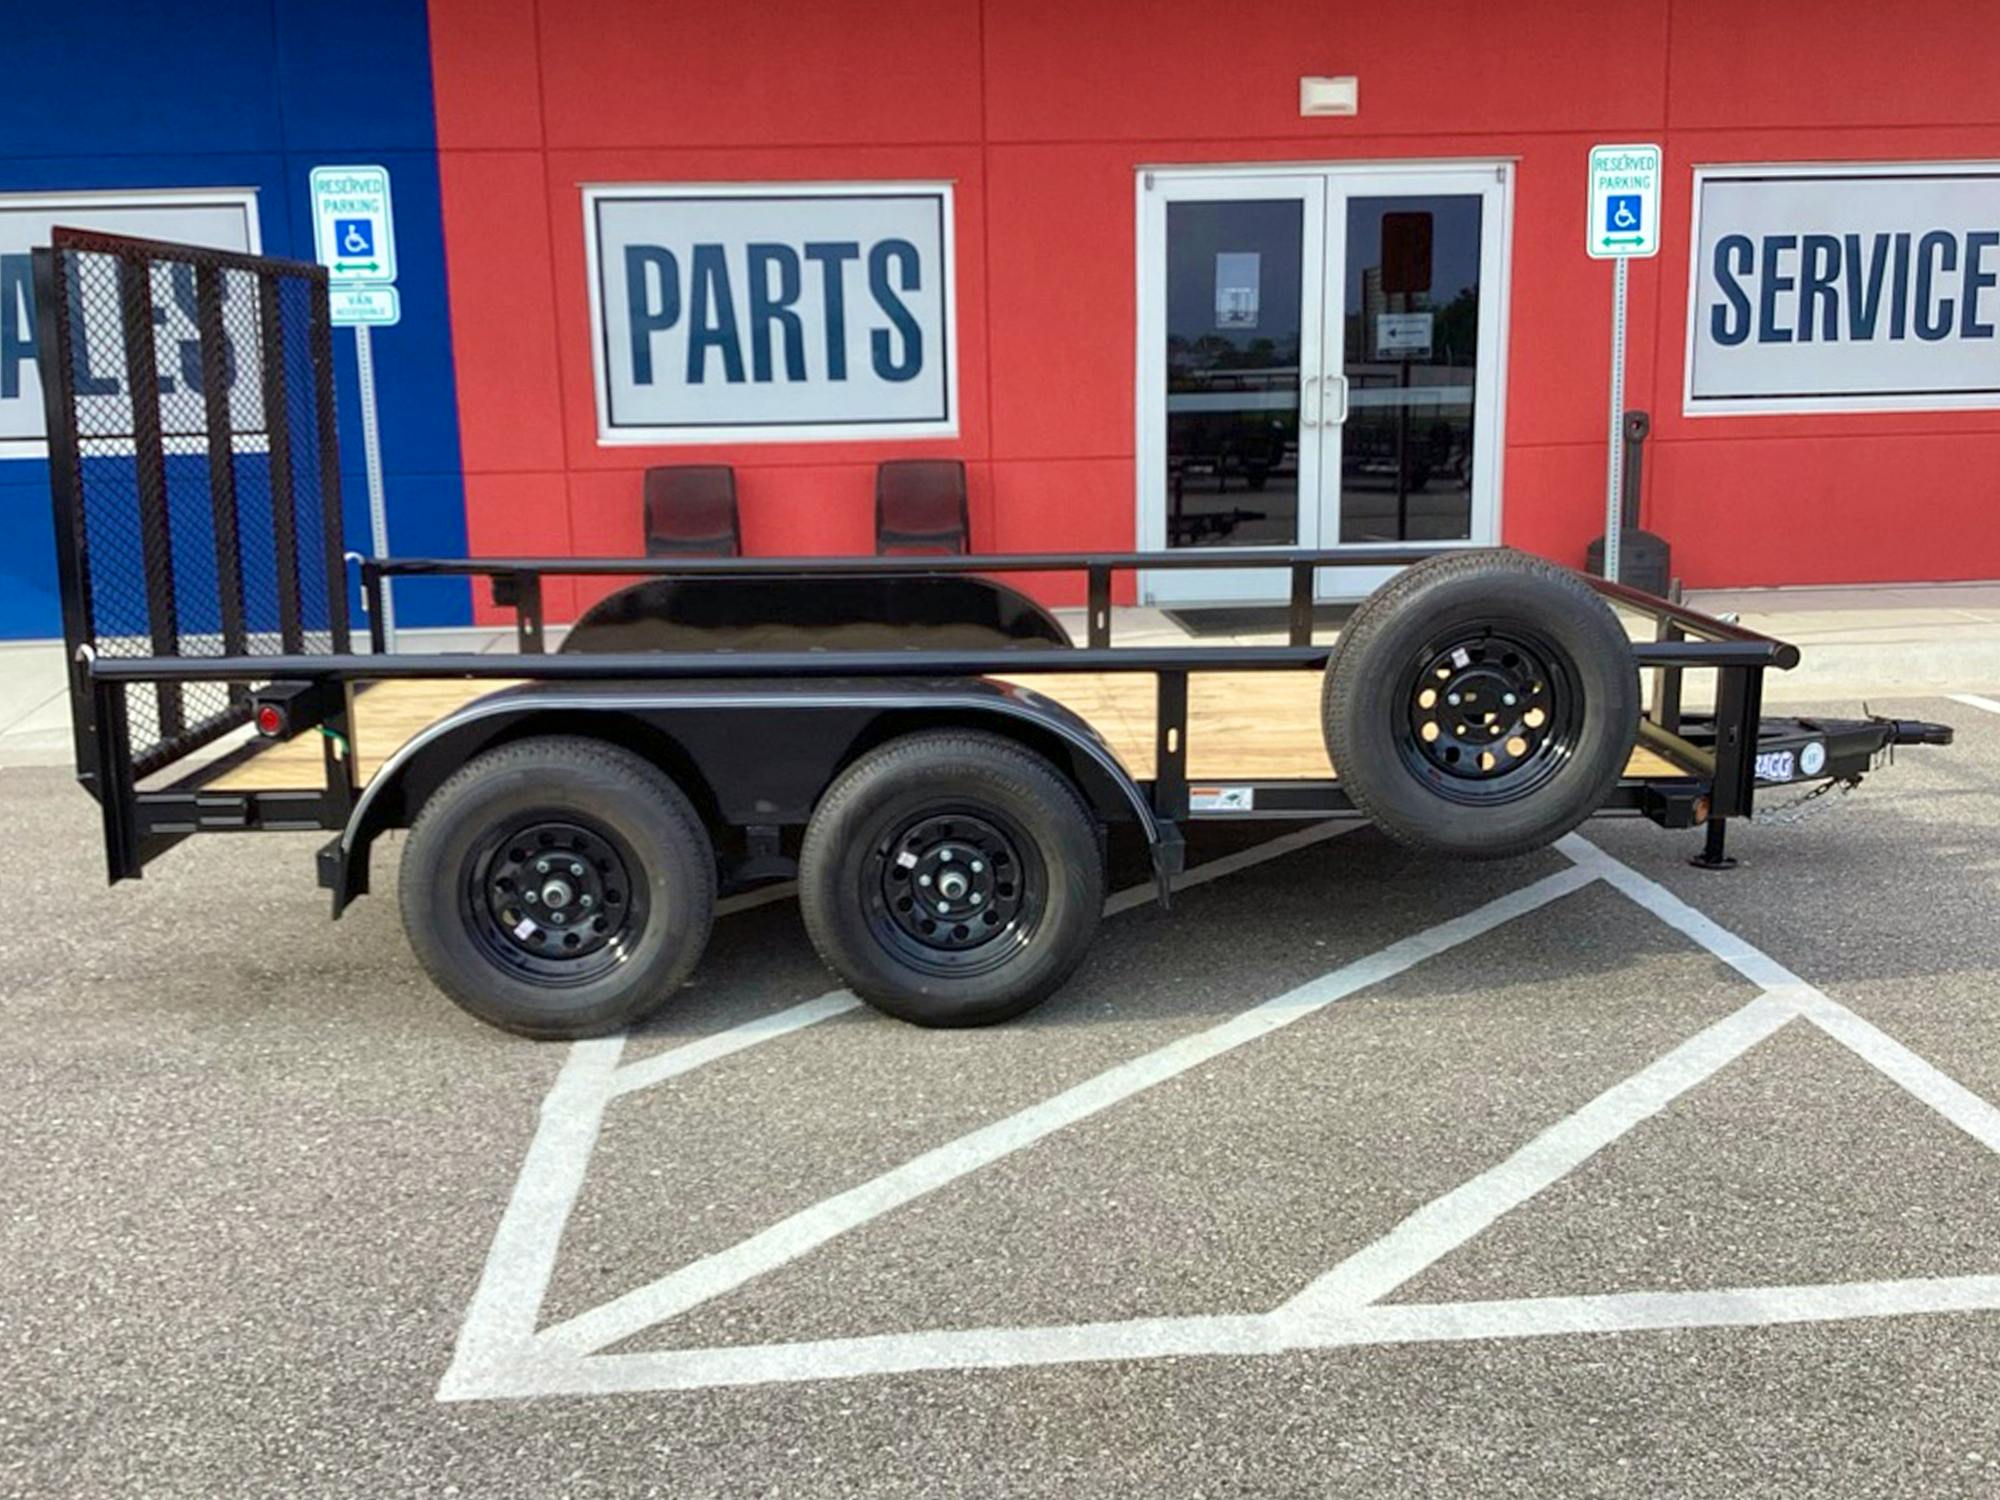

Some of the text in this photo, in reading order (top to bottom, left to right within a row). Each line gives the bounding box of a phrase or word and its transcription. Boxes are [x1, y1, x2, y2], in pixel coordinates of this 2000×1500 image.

[1594, 157, 1654, 171] RESERVED
[316, 178, 381, 194] RESERVED
[1599, 176, 1650, 189] PARKING
[323, 198, 380, 213] PARKING
[1711, 230, 2000, 346] SERVICE
[346, 295, 373, 305] VAN
[624, 238, 923, 384] PARTS
